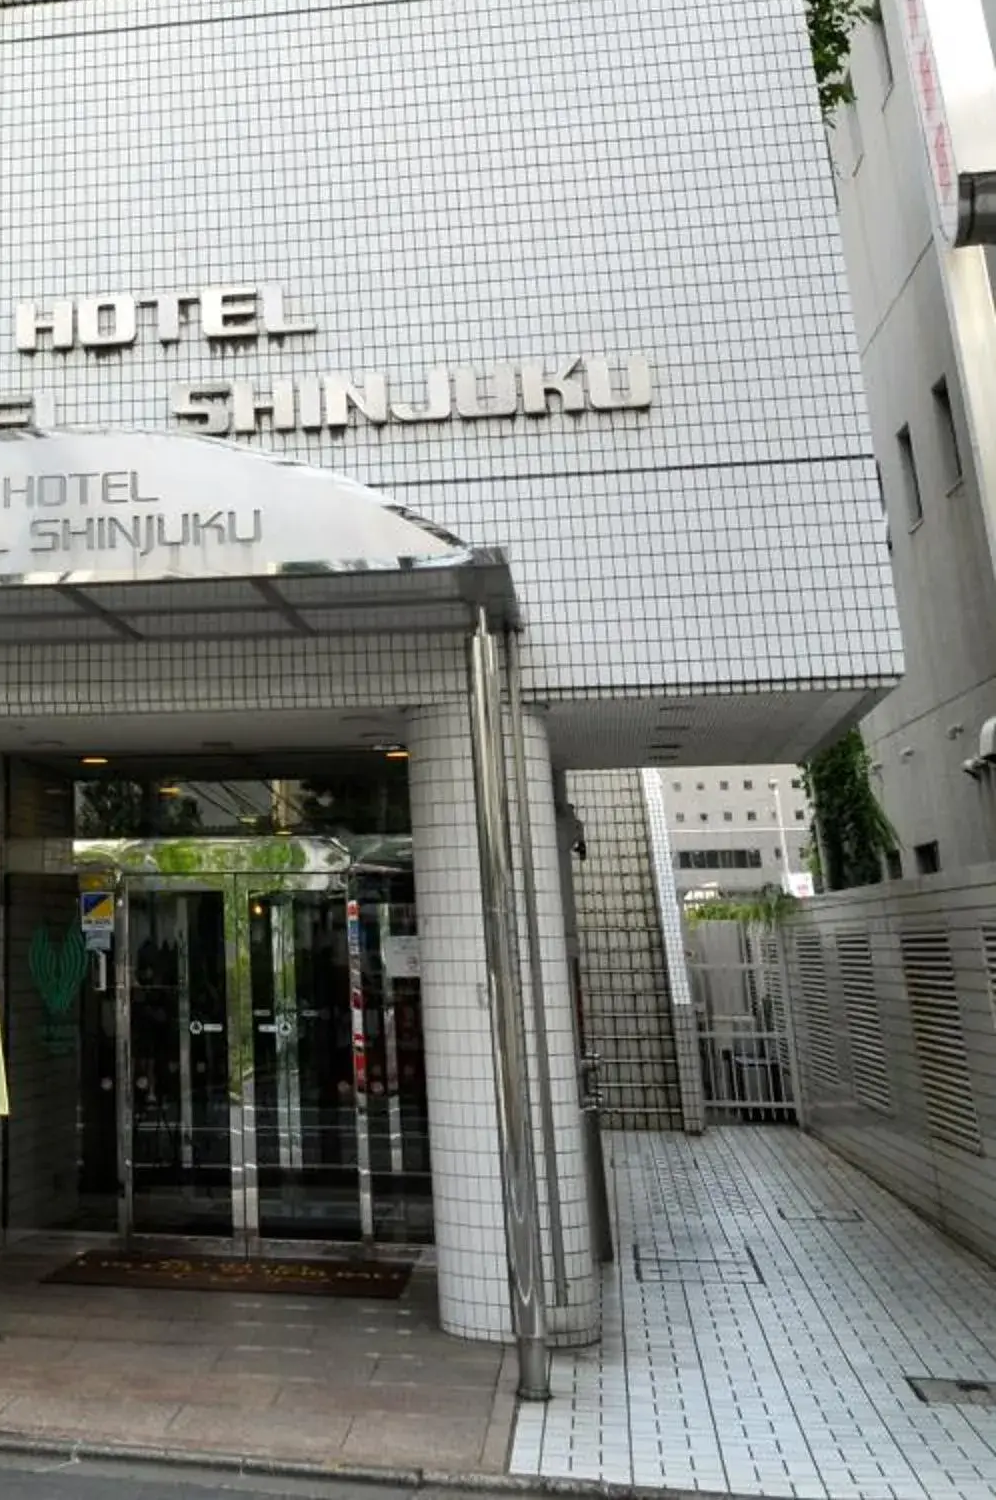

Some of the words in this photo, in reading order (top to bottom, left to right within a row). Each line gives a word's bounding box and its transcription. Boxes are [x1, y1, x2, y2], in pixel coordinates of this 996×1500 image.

[14, 283, 317, 350] HOTEL
[171, 354, 652, 435] SHINJUKU
[2, 470, 159, 509] HOTEL
[29, 509, 262, 556] SHINJUKU
